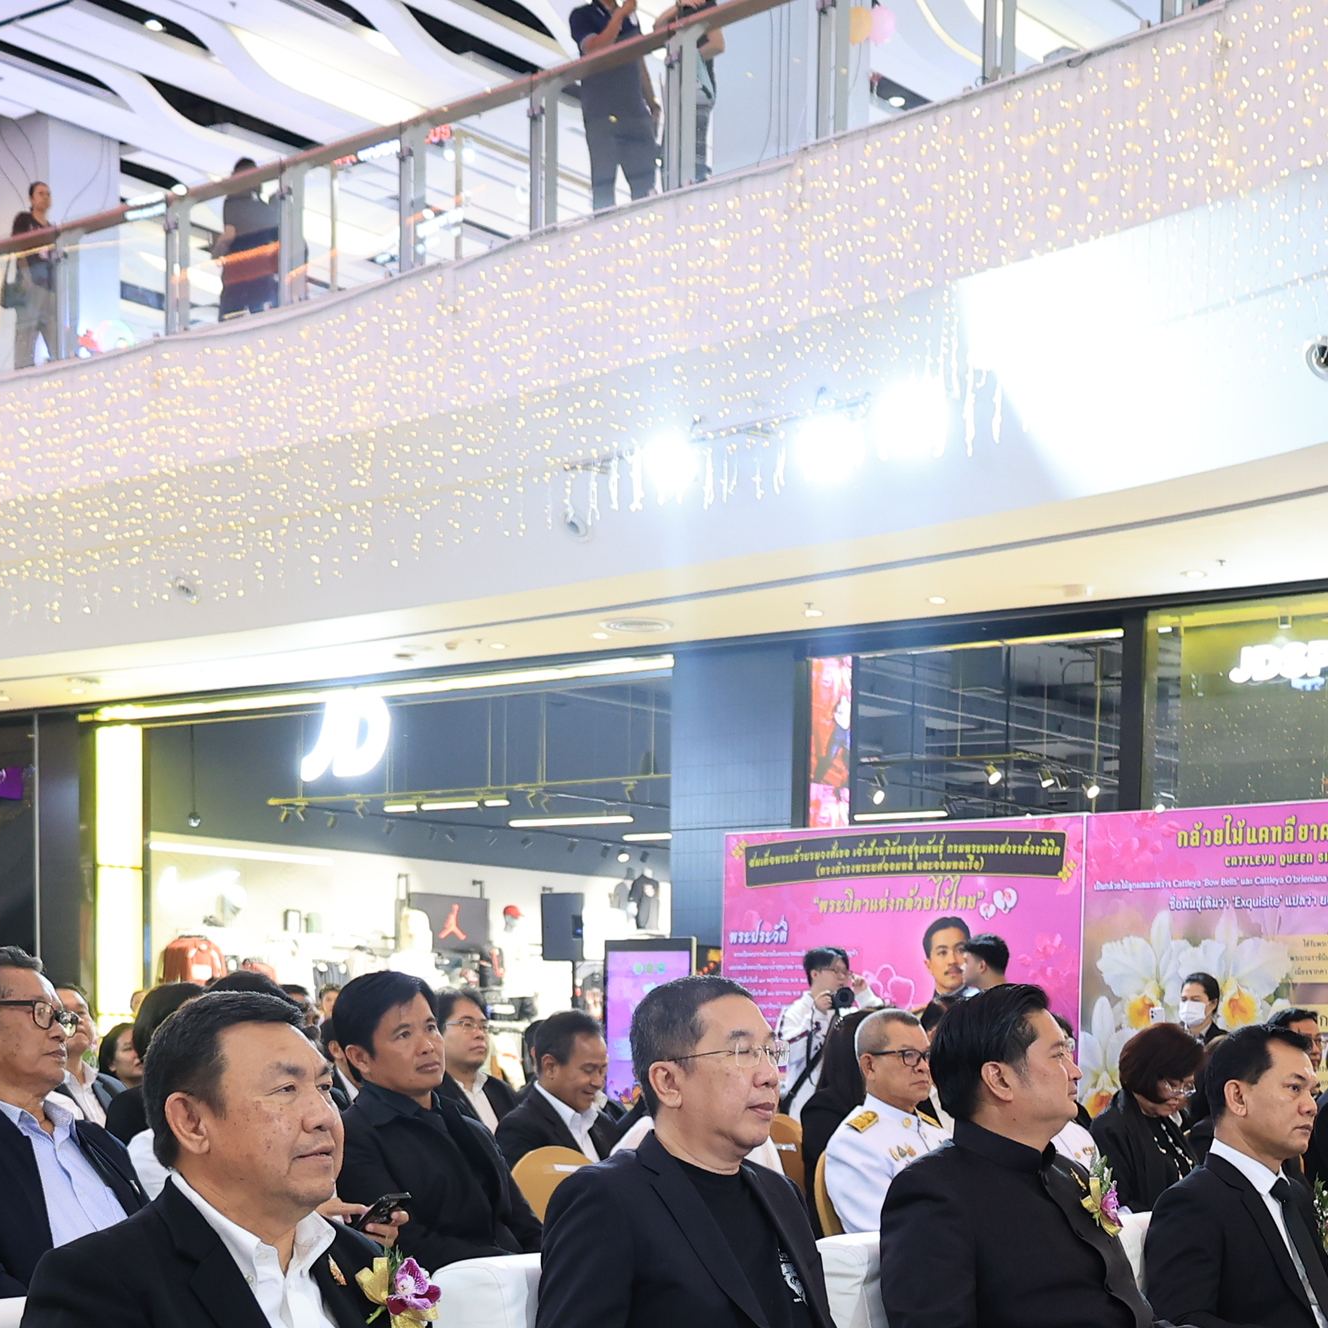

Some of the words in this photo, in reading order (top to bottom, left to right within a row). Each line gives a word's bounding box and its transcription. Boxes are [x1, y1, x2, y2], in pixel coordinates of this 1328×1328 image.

[300, 690, 391, 782] JD
[1225, 854, 1275, 867] CATTLEYA
[1279, 853, 1313, 867] QUEEN
[1173, 878, 1202, 889] Cattleya
[1255, 875, 1284, 887] Cattleya
[1285, 890, 1317, 908] แปลว่า
[728, 915, 789, 945] พระประวัติ
